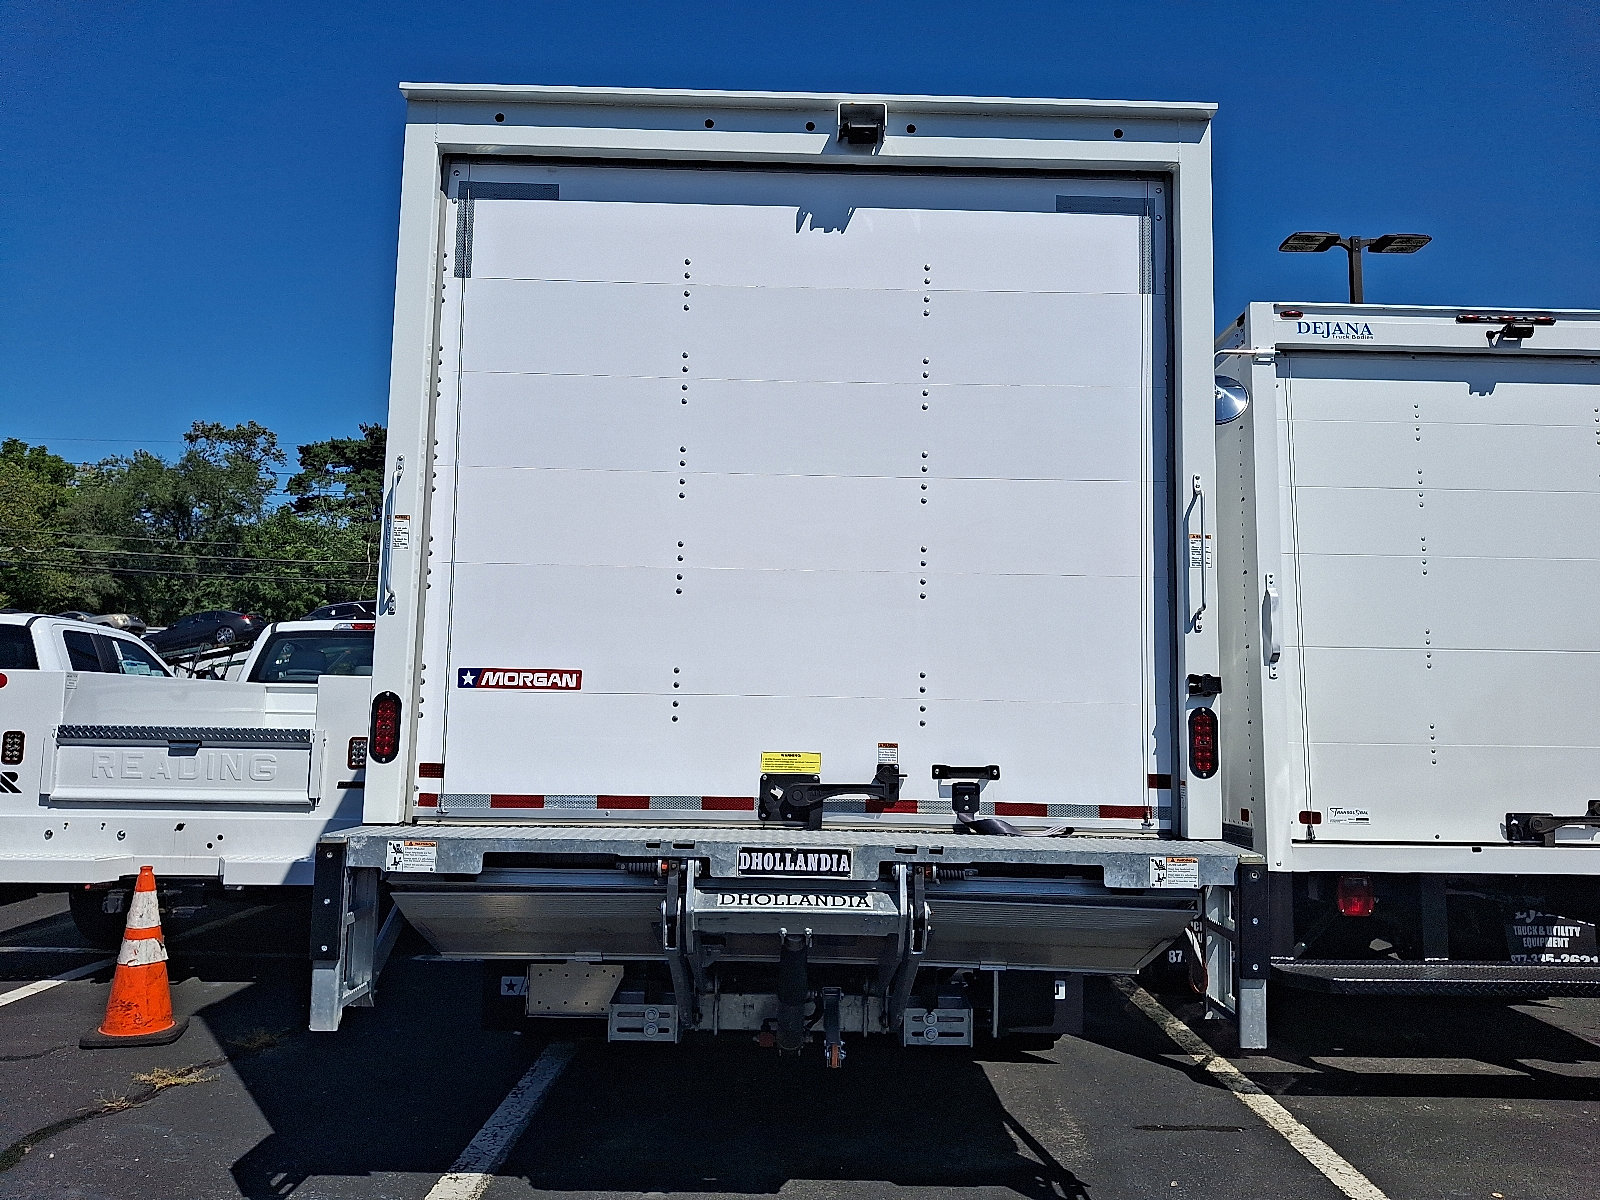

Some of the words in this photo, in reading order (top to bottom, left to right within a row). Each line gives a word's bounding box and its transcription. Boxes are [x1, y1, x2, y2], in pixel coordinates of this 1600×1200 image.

[1297, 321, 1374, 338] DEJANA
[481, 671, 577, 687] MORGAN
[91, 751, 278, 782] READING
[738, 852, 851, 872] DHOLLANDIA
[719, 893, 872, 908] DHOLLANDIA
[1513, 926, 1538, 936] TRUCK
[1546, 926, 1581, 937] UTILITY
[1522, 937, 1570, 948] EQUIPMENT
